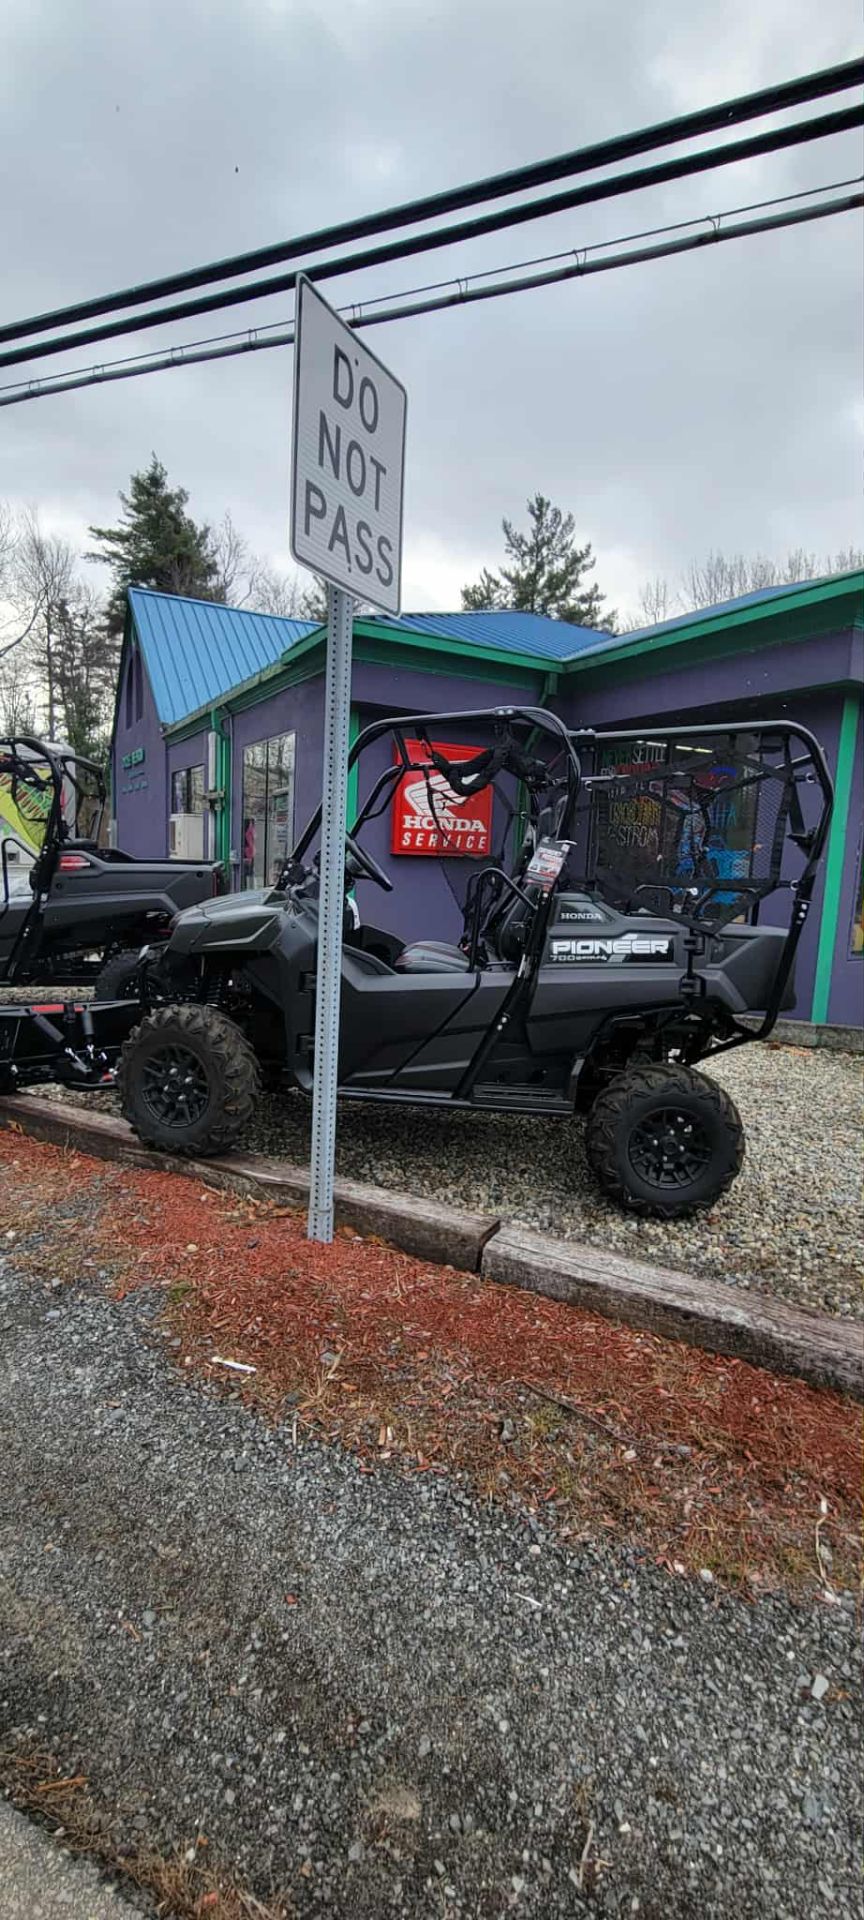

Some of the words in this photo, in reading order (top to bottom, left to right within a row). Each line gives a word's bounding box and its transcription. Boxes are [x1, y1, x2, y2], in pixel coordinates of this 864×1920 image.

[333, 343, 379, 434] DO
[318, 409, 387, 512] NOT
[304, 478, 394, 588] PASS
[402, 815, 487, 833] HONDA
[402, 832, 487, 849] SERVICE
[560, 912, 602, 920] HONDA
[551, 940, 669, 955] PIONEER
